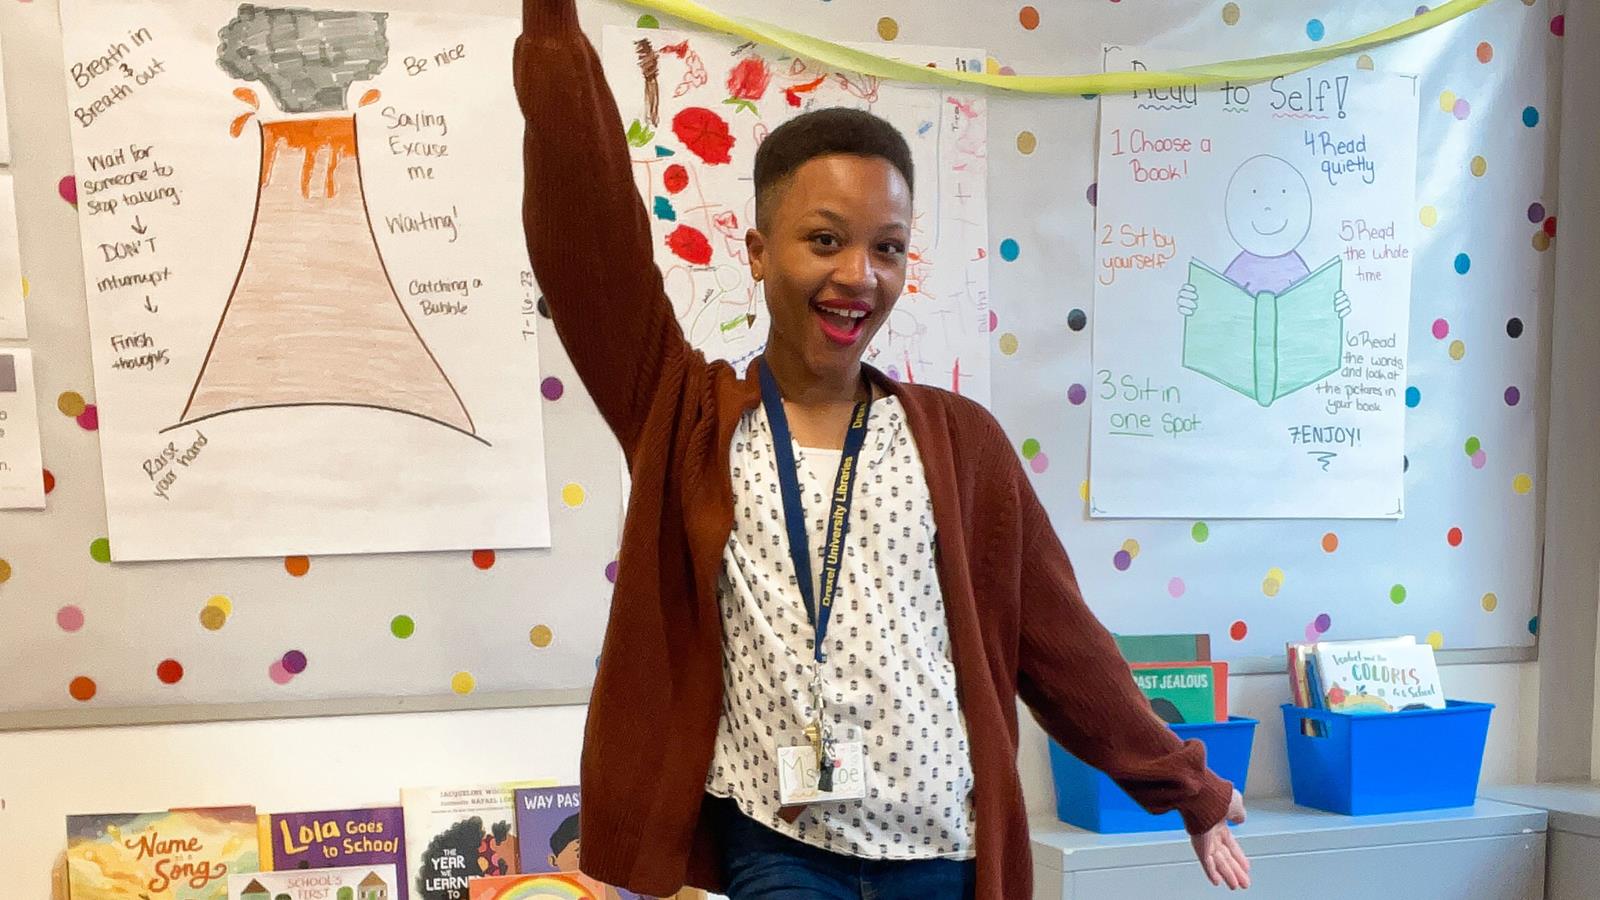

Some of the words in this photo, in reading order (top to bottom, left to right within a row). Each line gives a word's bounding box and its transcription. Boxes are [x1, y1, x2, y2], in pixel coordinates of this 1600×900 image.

[70, 41, 130, 89] Breath
[128, 26, 153, 47] in
[403, 56, 428, 77] Be
[434, 43, 466, 67] nice
[74, 81, 133, 128] Breath
[135, 57, 167, 86] out
[1220, 81, 1250, 105] to
[1270, 75, 1349, 119] Self!
[381, 106, 447, 136] Saying
[388, 135, 449, 157] Excuse
[1111, 129, 1124, 156] 1
[1131, 129, 1192, 153] Choose
[1200, 138, 1211, 153] a
[1304, 130, 1315, 156] 4
[1318, 131, 1366, 156] Read
[87, 148, 126, 171] Wait
[130, 144, 154, 162] for
[152, 161, 174, 177] to
[407, 166, 435, 180] me
[1321, 155, 1374, 186] quietly
[1101, 224, 1113, 245] 2
[1120, 224, 1149, 247] Sit
[1153, 227, 1176, 259] by
[1338, 219, 1354, 241] 5
[1355, 219, 1394, 240] Read
[97, 237, 157, 263] DON'T
[1344, 245, 1366, 261] the
[1372, 243, 1409, 260] whole
[1099, 253, 1166, 285] yourself
[1355, 265, 1382, 281] time
[408, 279, 469, 297] Catching
[472, 278, 483, 289] a
[419, 300, 468, 316] Bubble
[1346, 330, 1358, 347] 6
[1358, 330, 1396, 349] Read
[1343, 352, 1364, 364] the
[1341, 366, 1362, 378] and
[1387, 370, 1400, 380] at
[1097, 369, 1116, 399] 3
[1121, 374, 1158, 401] Sit
[1162, 386, 1180, 402] in
[1315, 380, 1341, 394] the
[1385, 387, 1396, 397] in
[1326, 399, 1352, 415] your
[1356, 399, 1381, 411] book
[1110, 413, 1151, 429] one
[835, 456, 853, 502] Libraries
[827, 505, 847, 564] University
[822, 567, 836, 607] Drexel
[1160, 674, 1208, 689] JEALOUS
[782, 756, 817, 789] Ms
[524, 795, 553, 810] WAY
[557, 792, 581, 809] PAS
[125, 832, 203, 861] Name
[279, 819, 341, 855] Lola
[346, 821, 384, 835] Goes
[323, 845, 338, 858] to
[343, 837, 399, 854] School
[431, 855, 466, 870] YEAR
[443, 848, 457, 857] THE
[148, 858, 227, 893] Song
[447, 890, 461, 900] TO
